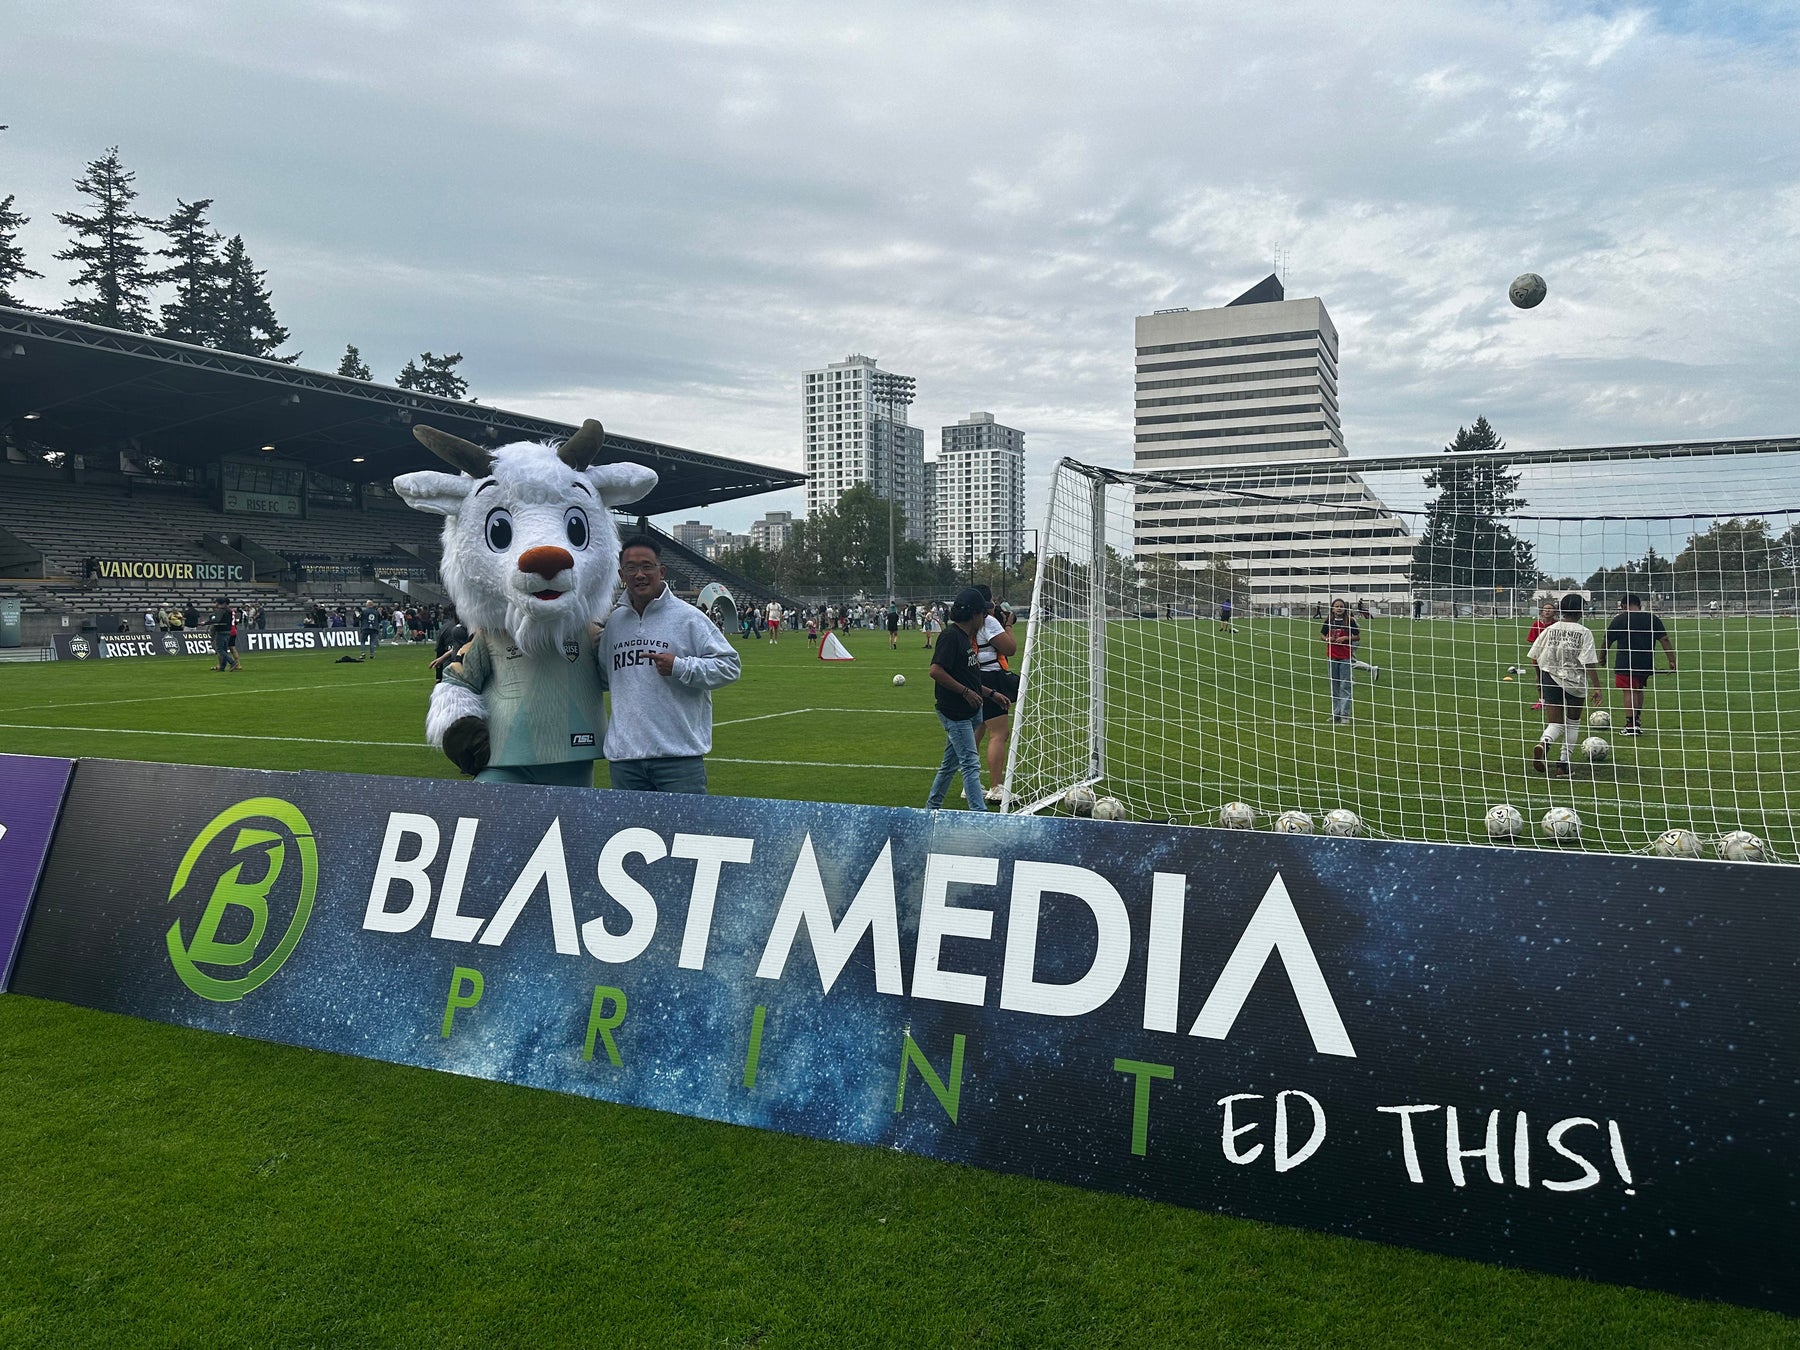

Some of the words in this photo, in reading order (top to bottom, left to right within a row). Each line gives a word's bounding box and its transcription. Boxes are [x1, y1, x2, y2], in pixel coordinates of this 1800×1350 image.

[246, 499, 267, 511] RISE
[268, 501, 280, 512] FC
[99, 561, 194, 579] VANCOUVER
[196, 564, 225, 580] RISE
[227, 565, 243, 580] FC
[72, 643, 88, 652] RISE
[247, 632, 315, 650] FITNESS
[319, 631, 370, 647] WORL
[564, 645, 578, 653] RISE
[613, 639, 669, 650] VANCOUVER
[106, 642, 138, 657] RISE
[138, 642, 156, 656] FC
[613, 649, 644, 671] RISE
[362, 811, 755, 971] BLAST
[755, 830, 1357, 1058] MEDIA
[1217, 1090, 1326, 1173] ED
[1375, 1104, 1636, 1196] THIS!
